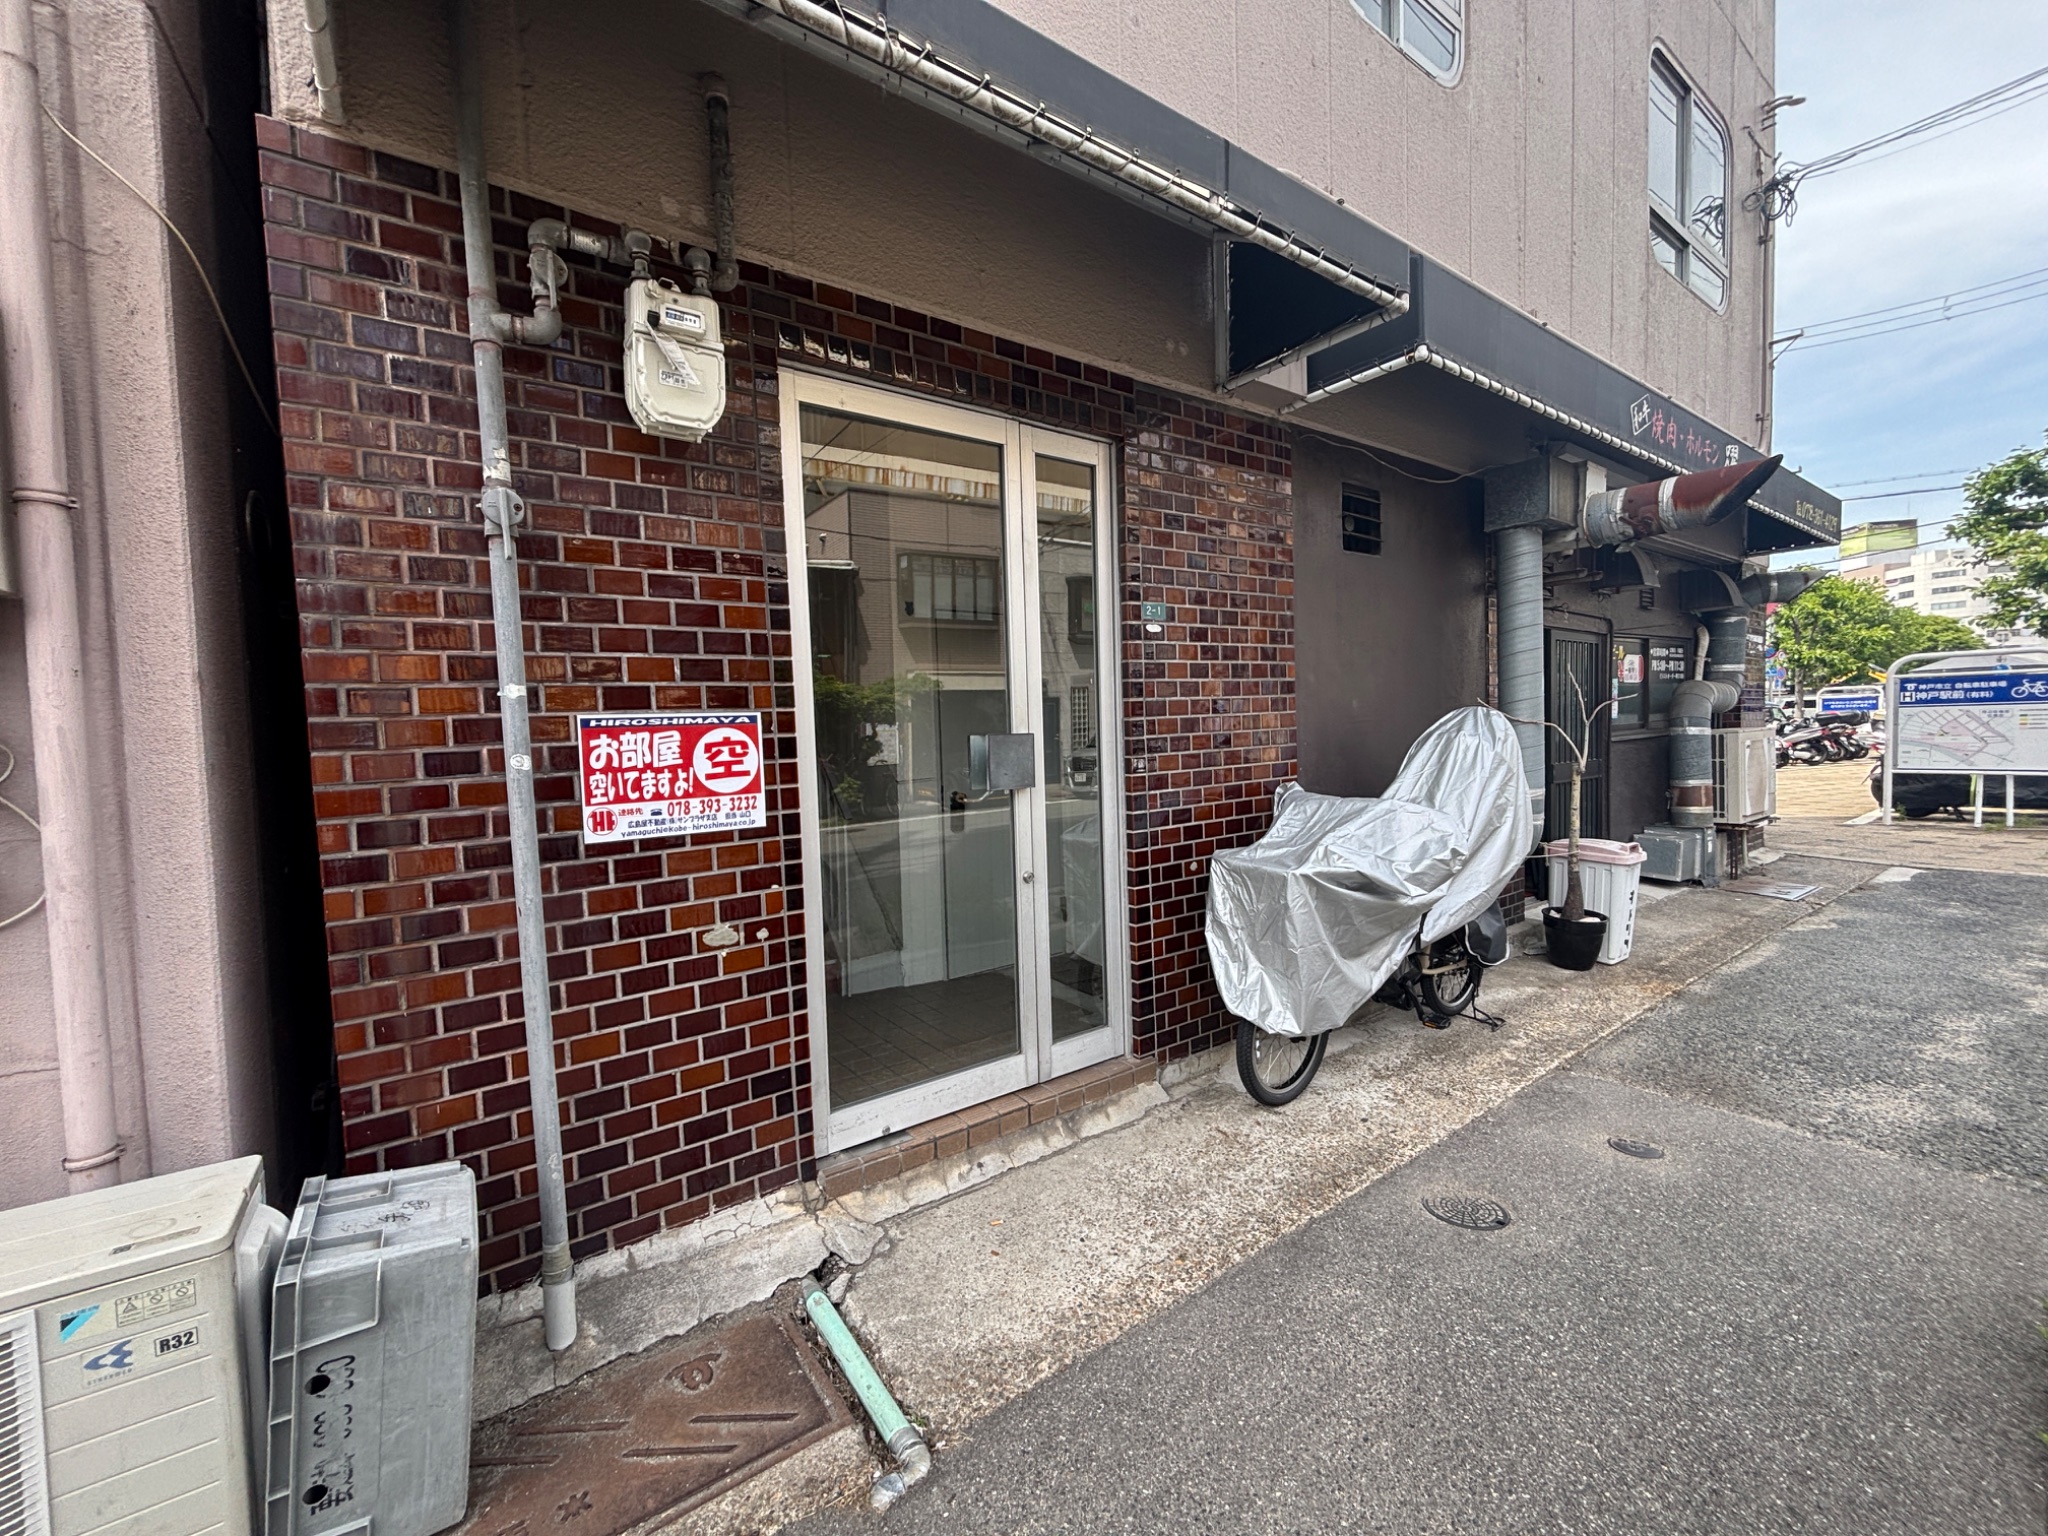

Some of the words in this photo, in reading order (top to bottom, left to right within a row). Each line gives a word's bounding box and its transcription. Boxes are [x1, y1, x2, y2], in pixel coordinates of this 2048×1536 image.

[1146, 605, 1161, 616] 2-1
[589, 716, 751, 727] HIROSHIMAYA
[589, 730, 684, 770] お部屋
[703, 736, 752, 781] 空
[589, 766, 695, 805] 空いてますよ!
[618, 807, 644, 817] 連絡先
[667, 795, 758, 817] 078-393-3232
[739, 810, 751, 818] 山口
[159, 1331, 194, 1353] R32
